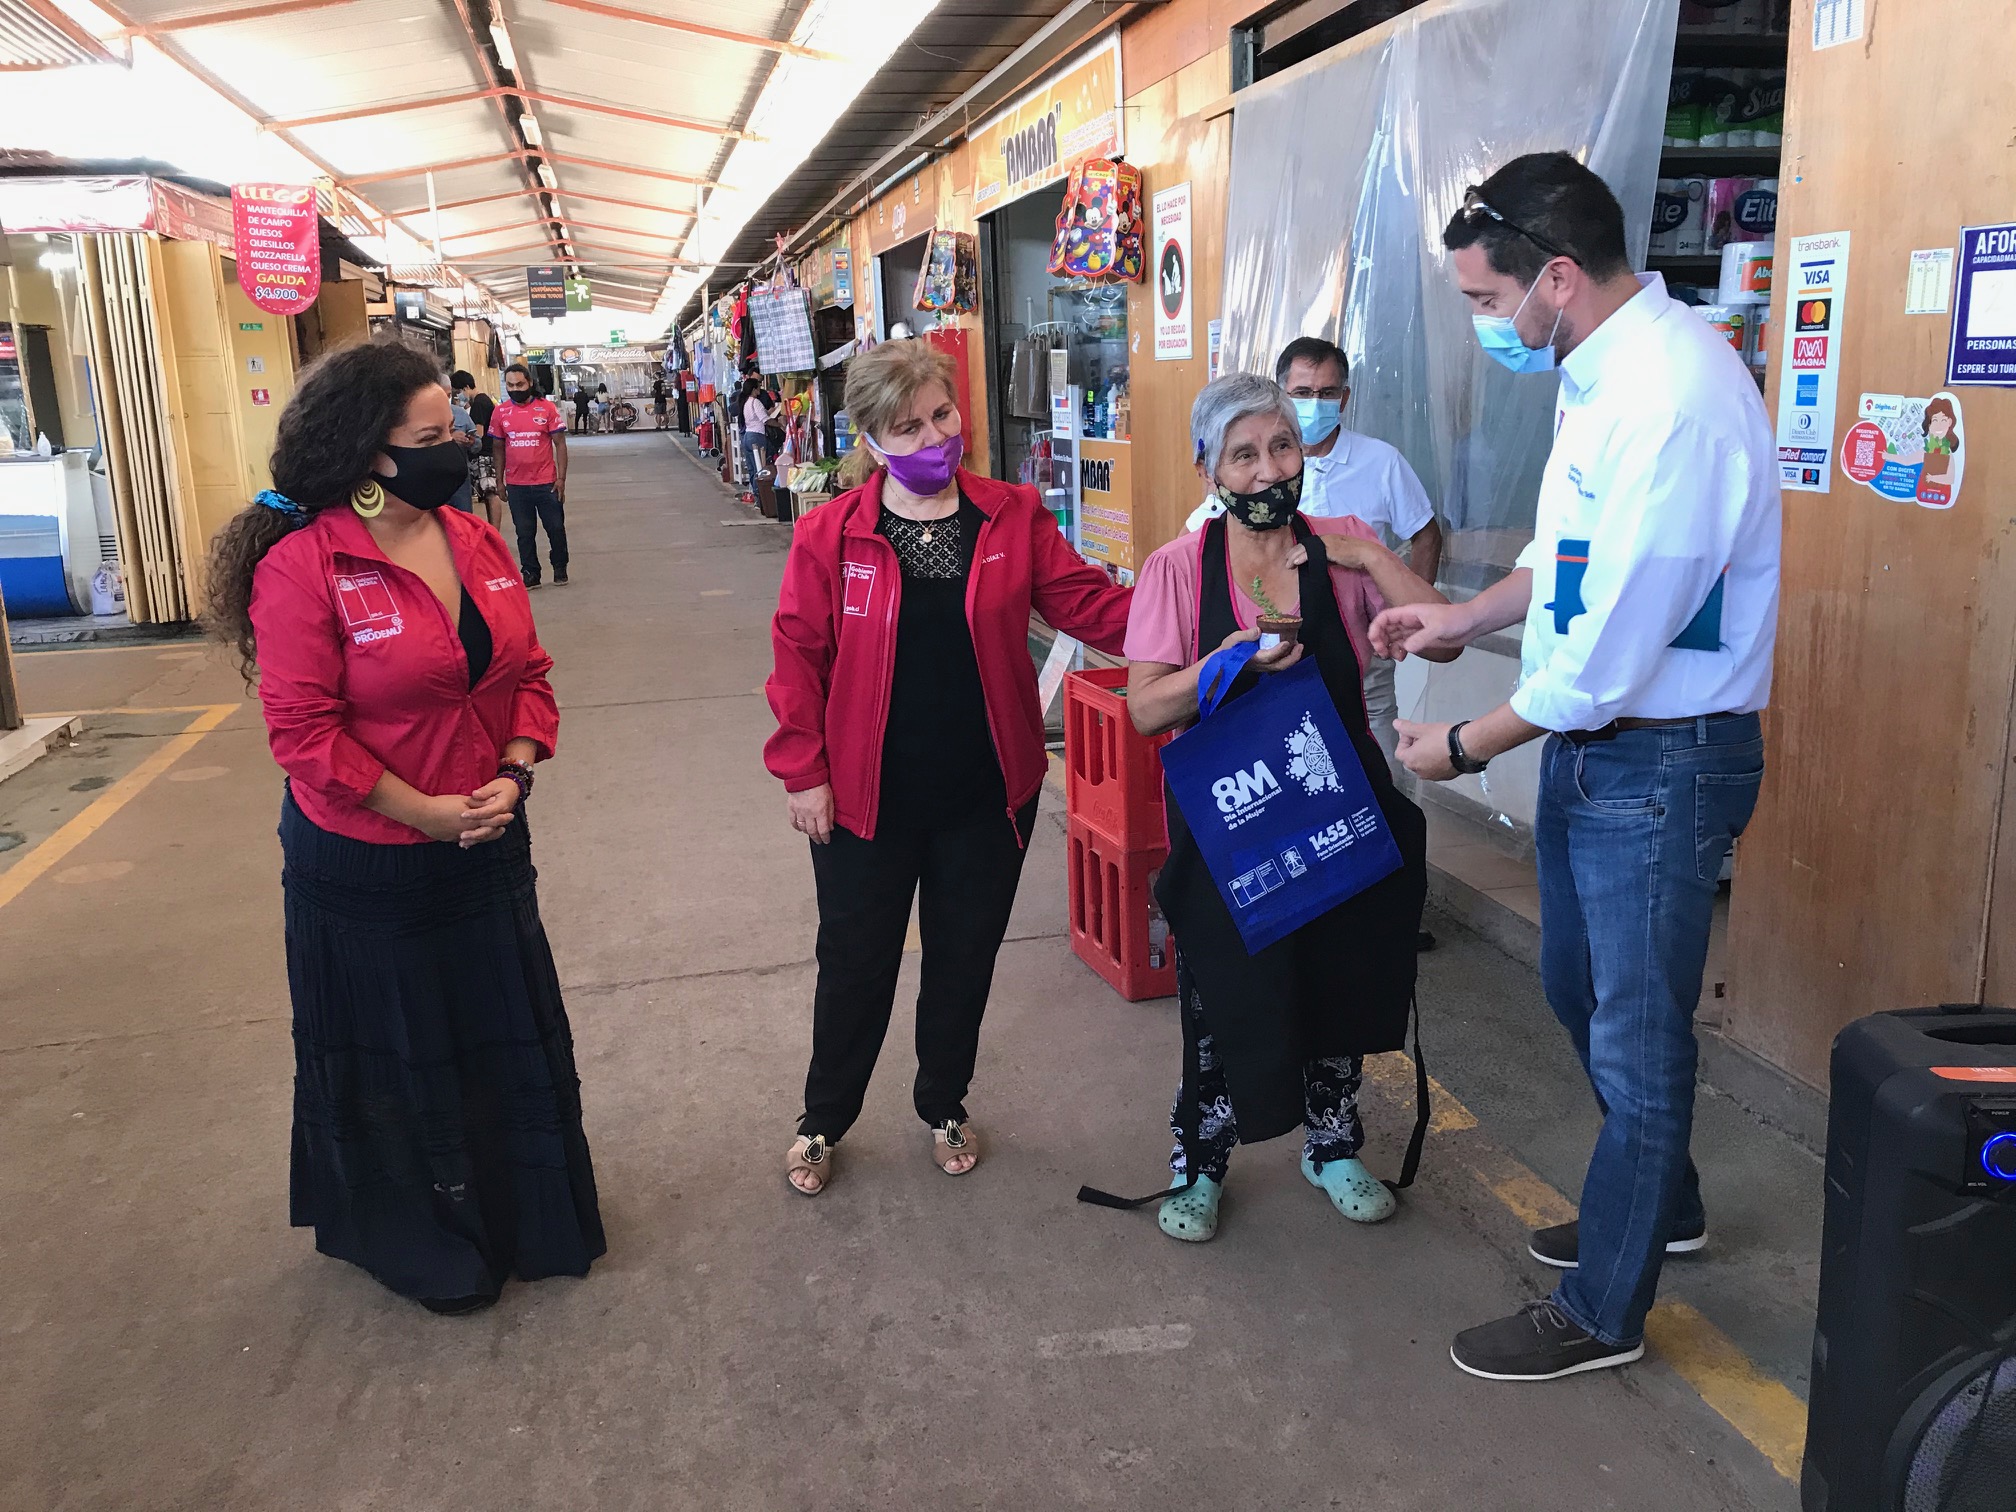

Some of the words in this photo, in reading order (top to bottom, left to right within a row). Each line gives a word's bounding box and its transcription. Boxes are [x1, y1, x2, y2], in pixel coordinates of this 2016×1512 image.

[1156, 205, 1162, 213] EL
[1162, 203, 1168, 212] LO
[1167, 198, 1178, 210] HACE
[1178, 195, 1187, 206] POR
[247, 204, 308, 218] MANTEQUILLA
[248, 216, 259, 225] DE
[261, 217, 293, 228] CAMPO
[1160, 211, 1182, 227] NECESIDAD
[248, 227, 283, 238] QUESOS
[249, 238, 295, 250] QUESILLOS
[250, 250, 307, 262] MOZZARELLA
[1973, 255, 2005, 264] CAPACIDAD
[251, 261, 281, 271] QUESO
[282, 263, 312, 273] CREMA
[256, 273, 307, 286] GAUDA
[1804, 269, 1830, 285] VISA
[255, 286, 299, 300] $4.900
[1165, 325, 1170, 335] LO
[1170, 323, 1186, 335] RECOJO
[1166, 337, 1188, 349] EDUCACION
[589, 348, 647, 360] Empanadas
[1793, 356, 1826, 367] MAGNA
[1957, 364, 1986, 374] ESPERE
[1987, 363, 1999, 374] SU
[1791, 428, 1805, 436] Diners
[1805, 428, 1817, 436] Club
[1784, 448, 1800, 461] Red
[1784, 470, 1797, 479] VISA
[850, 565, 874, 575] Gobierno
[857, 572, 870, 580] Chile
[354, 625, 403, 646] PRODEMU
[1211, 759, 1279, 813] 8M
[1223, 810, 1237, 823] Día
[1236, 786, 1283, 817] Internacional
[1228, 821, 1238, 831] de
[1237, 816, 1246, 826] la
[1245, 806, 1266, 822] Mujer
[1308, 818, 1349, 851] 1455
[1316, 848, 1330, 859] Fono
[1329, 834, 1355, 852] Orientación
